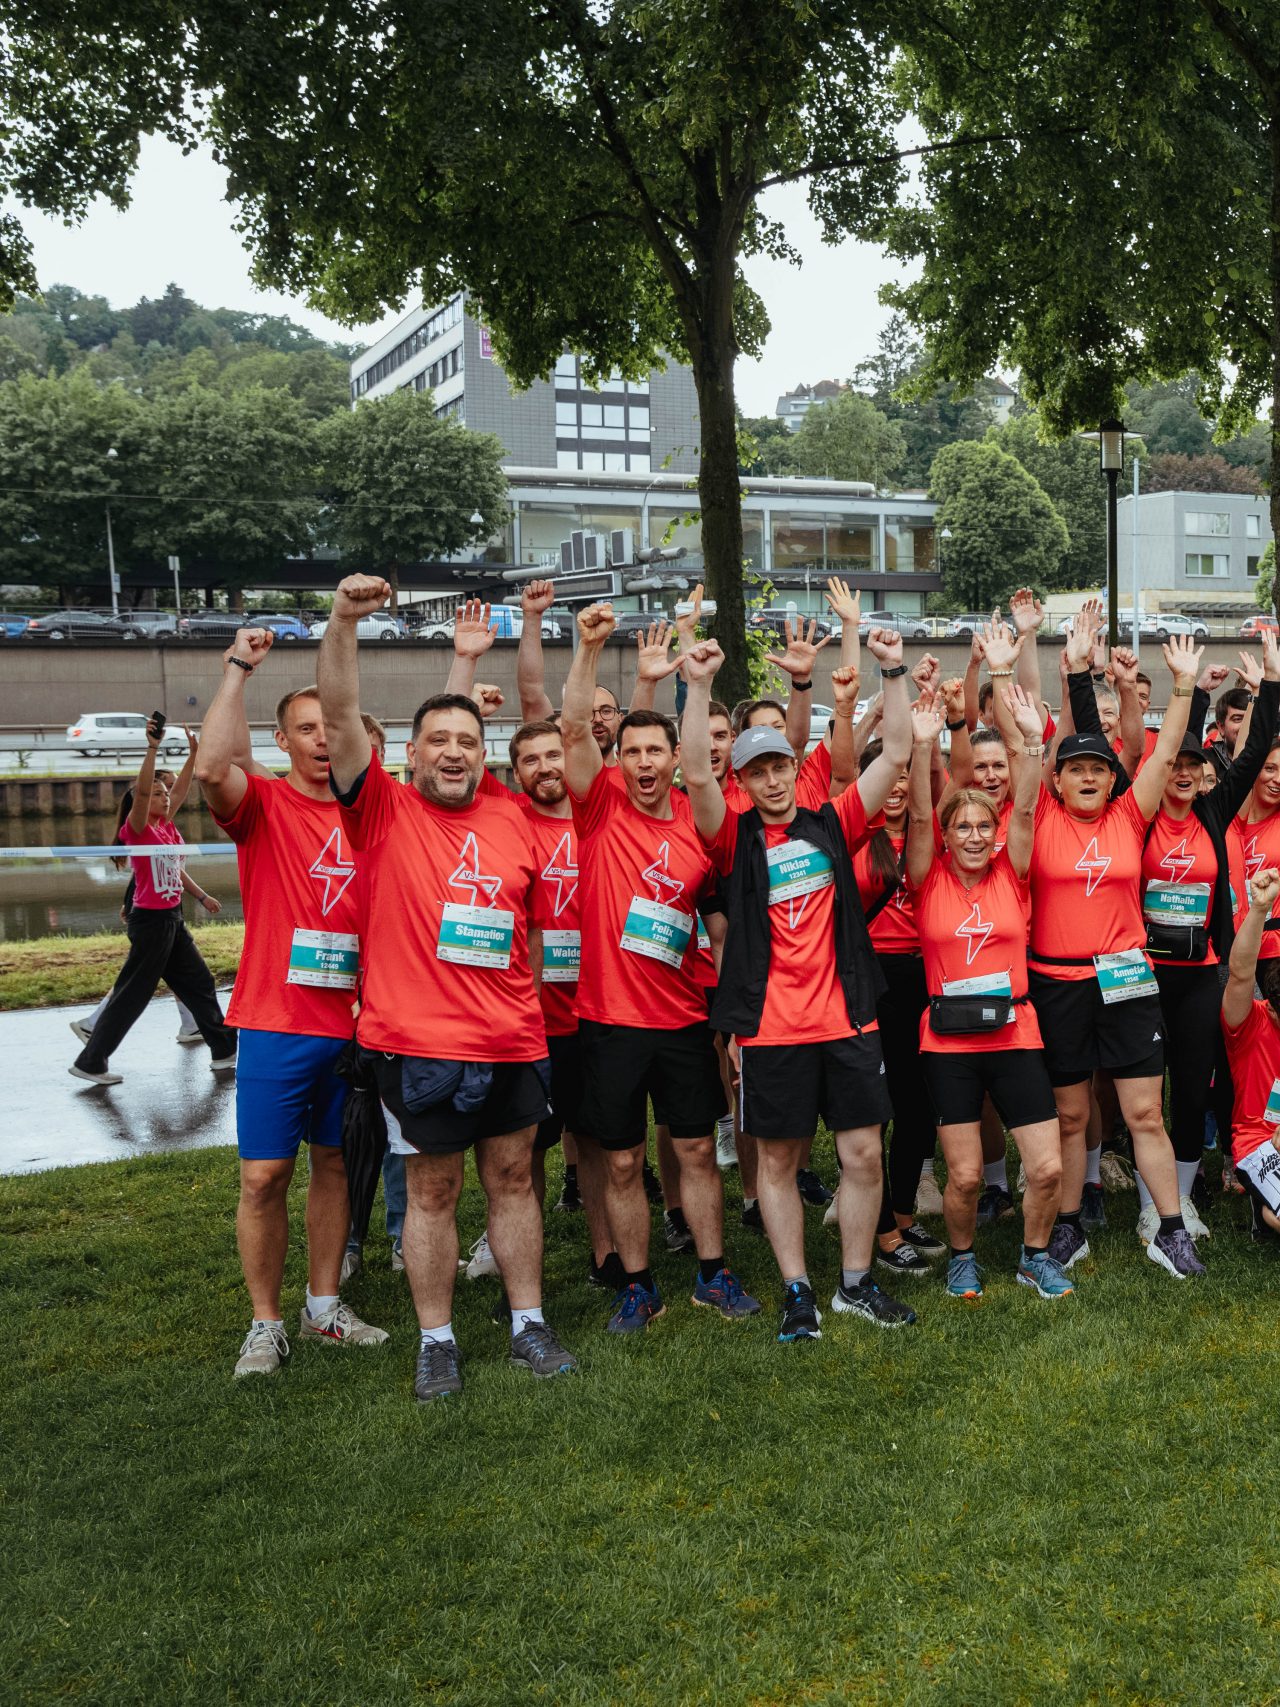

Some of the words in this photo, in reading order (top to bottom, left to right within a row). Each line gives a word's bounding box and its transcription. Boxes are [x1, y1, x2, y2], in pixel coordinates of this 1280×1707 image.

[778, 858, 811, 875] Niklas
[1160, 892, 1196, 906] Nathalie
[455, 924, 506, 942] Stamatios
[651, 920, 675, 938] Felix
[315, 949, 345, 962] Frank
[1113, 965, 1146, 979] Annette
[1261, 1152, 1279, 1168] Los
